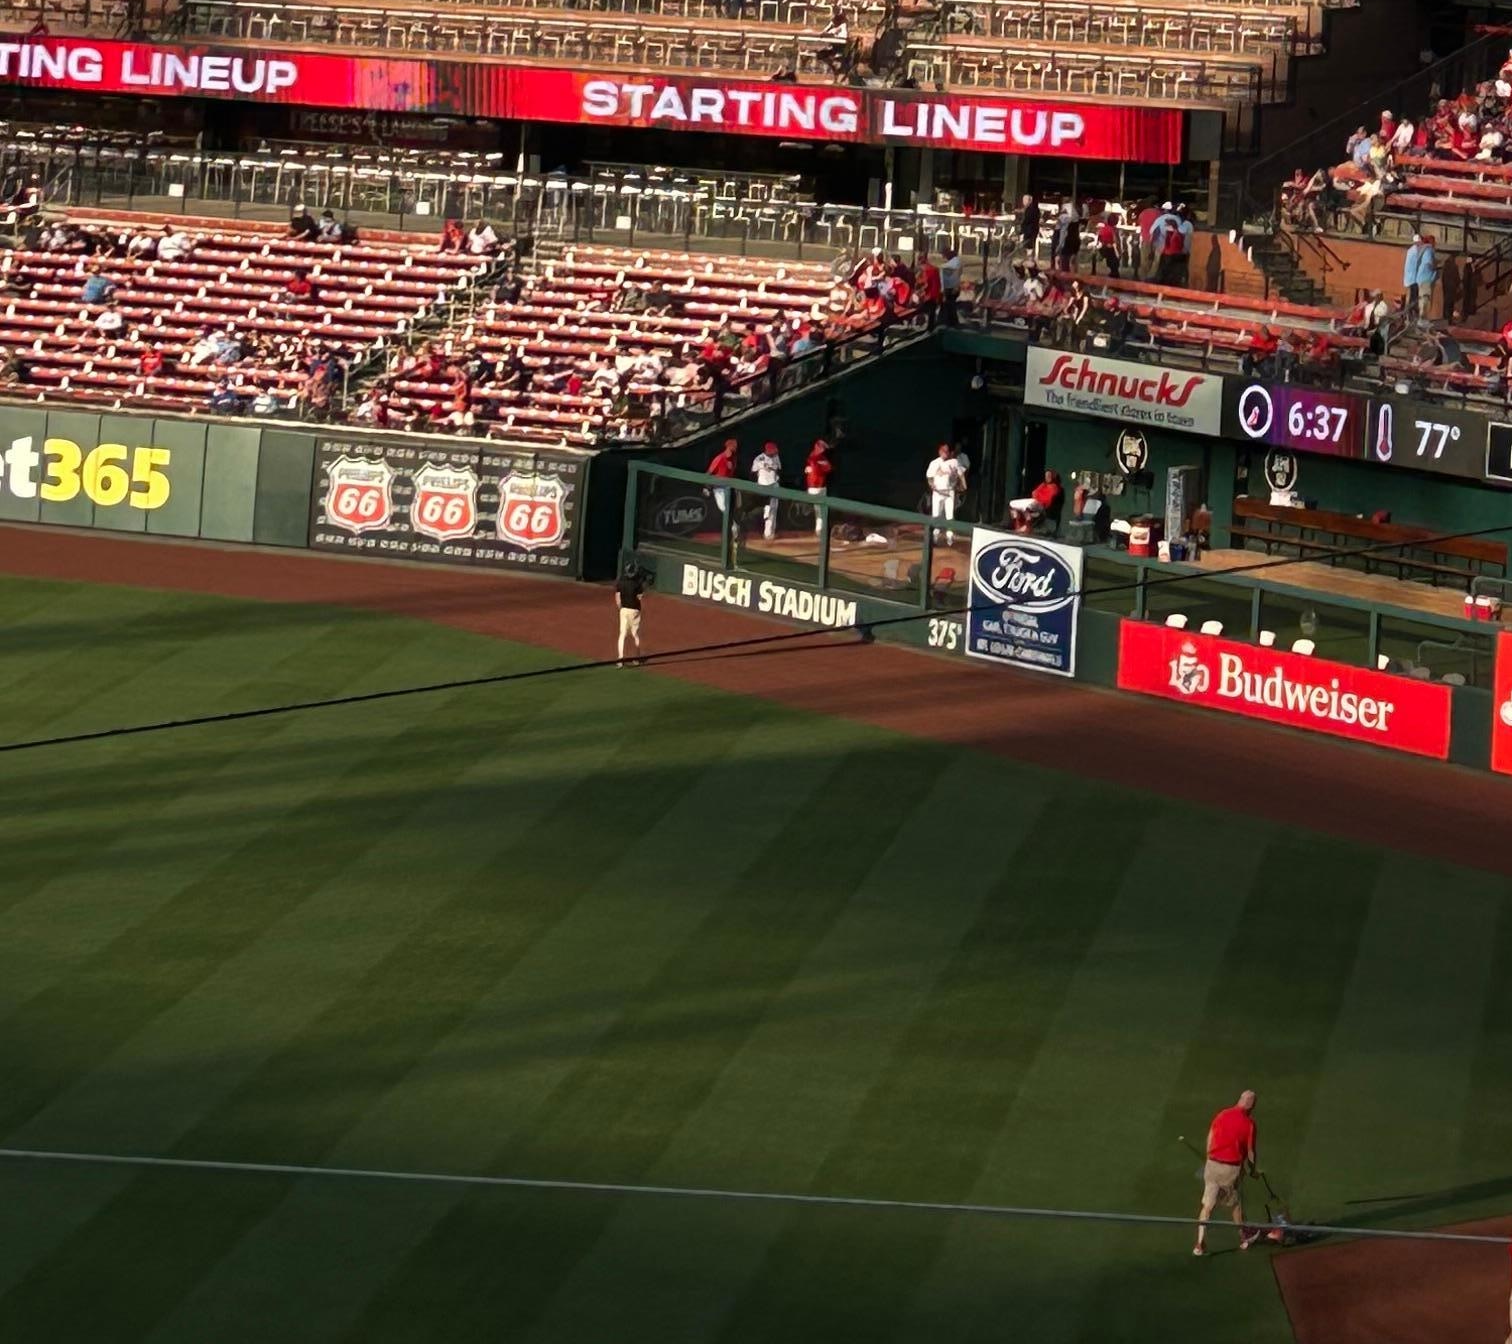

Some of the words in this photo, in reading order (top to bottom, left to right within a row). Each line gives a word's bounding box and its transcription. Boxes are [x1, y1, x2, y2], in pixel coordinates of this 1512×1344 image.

[120, 51, 298, 95] LINEUP
[581, 80, 859, 134] STARTING
[881, 99, 1086, 147] LINEUP
[1038, 355, 1206, 408] Schnucks
[1287, 401, 1348, 443] 6:37
[1414, 419, 1462, 460] 77°
[0, 436, 171, 510] t365
[338, 487, 384, 524] 66
[421, 495, 466, 532] 66
[508, 503, 553, 540] 66
[682, 563, 753, 609] BUSCH
[757, 579, 858, 628] STADIUM
[990, 547, 1056, 597] Ford
[1216, 651, 1395, 732] Budweiser
